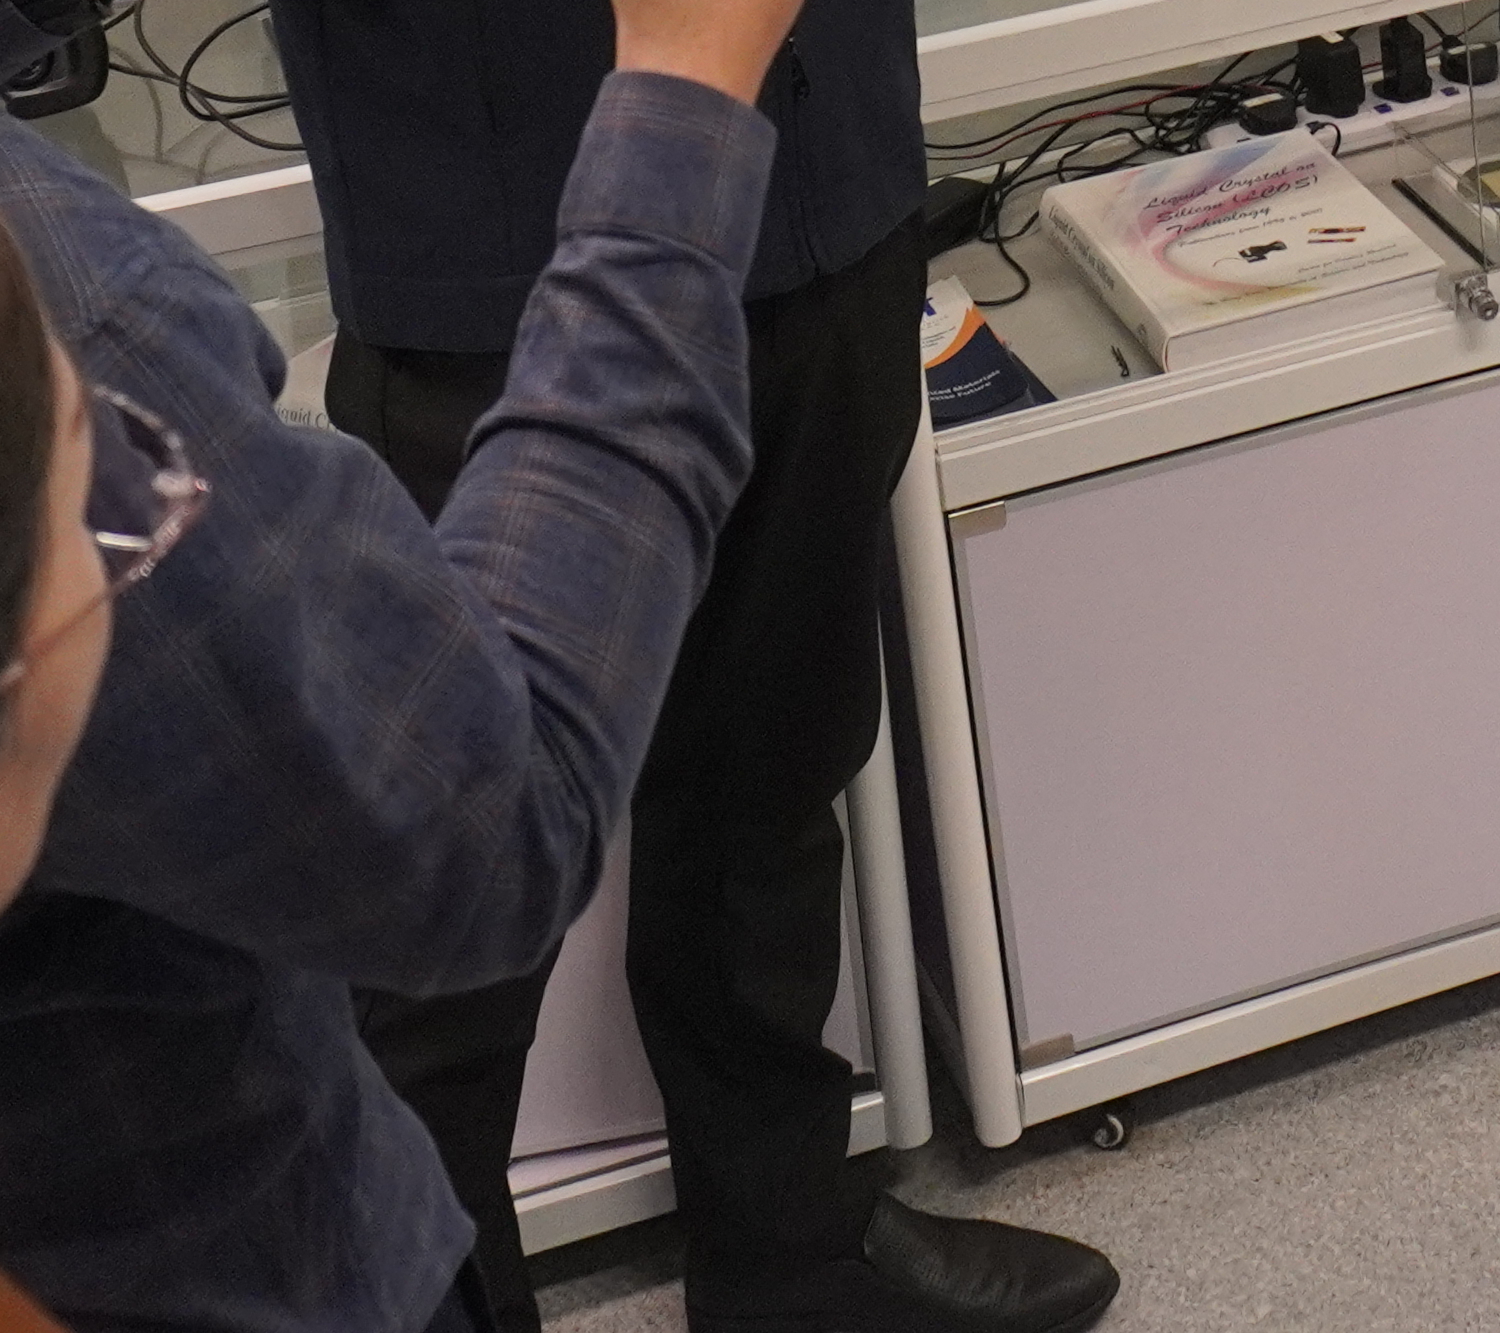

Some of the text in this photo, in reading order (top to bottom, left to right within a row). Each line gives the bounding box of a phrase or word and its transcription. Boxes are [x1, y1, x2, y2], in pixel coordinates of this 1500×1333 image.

[1143, 187, 1208, 210] Liquid
[1219, 166, 1287, 192] Crystal
[1157, 202, 1224, 224] Silicon
[1166, 206, 1271, 234] Technology
